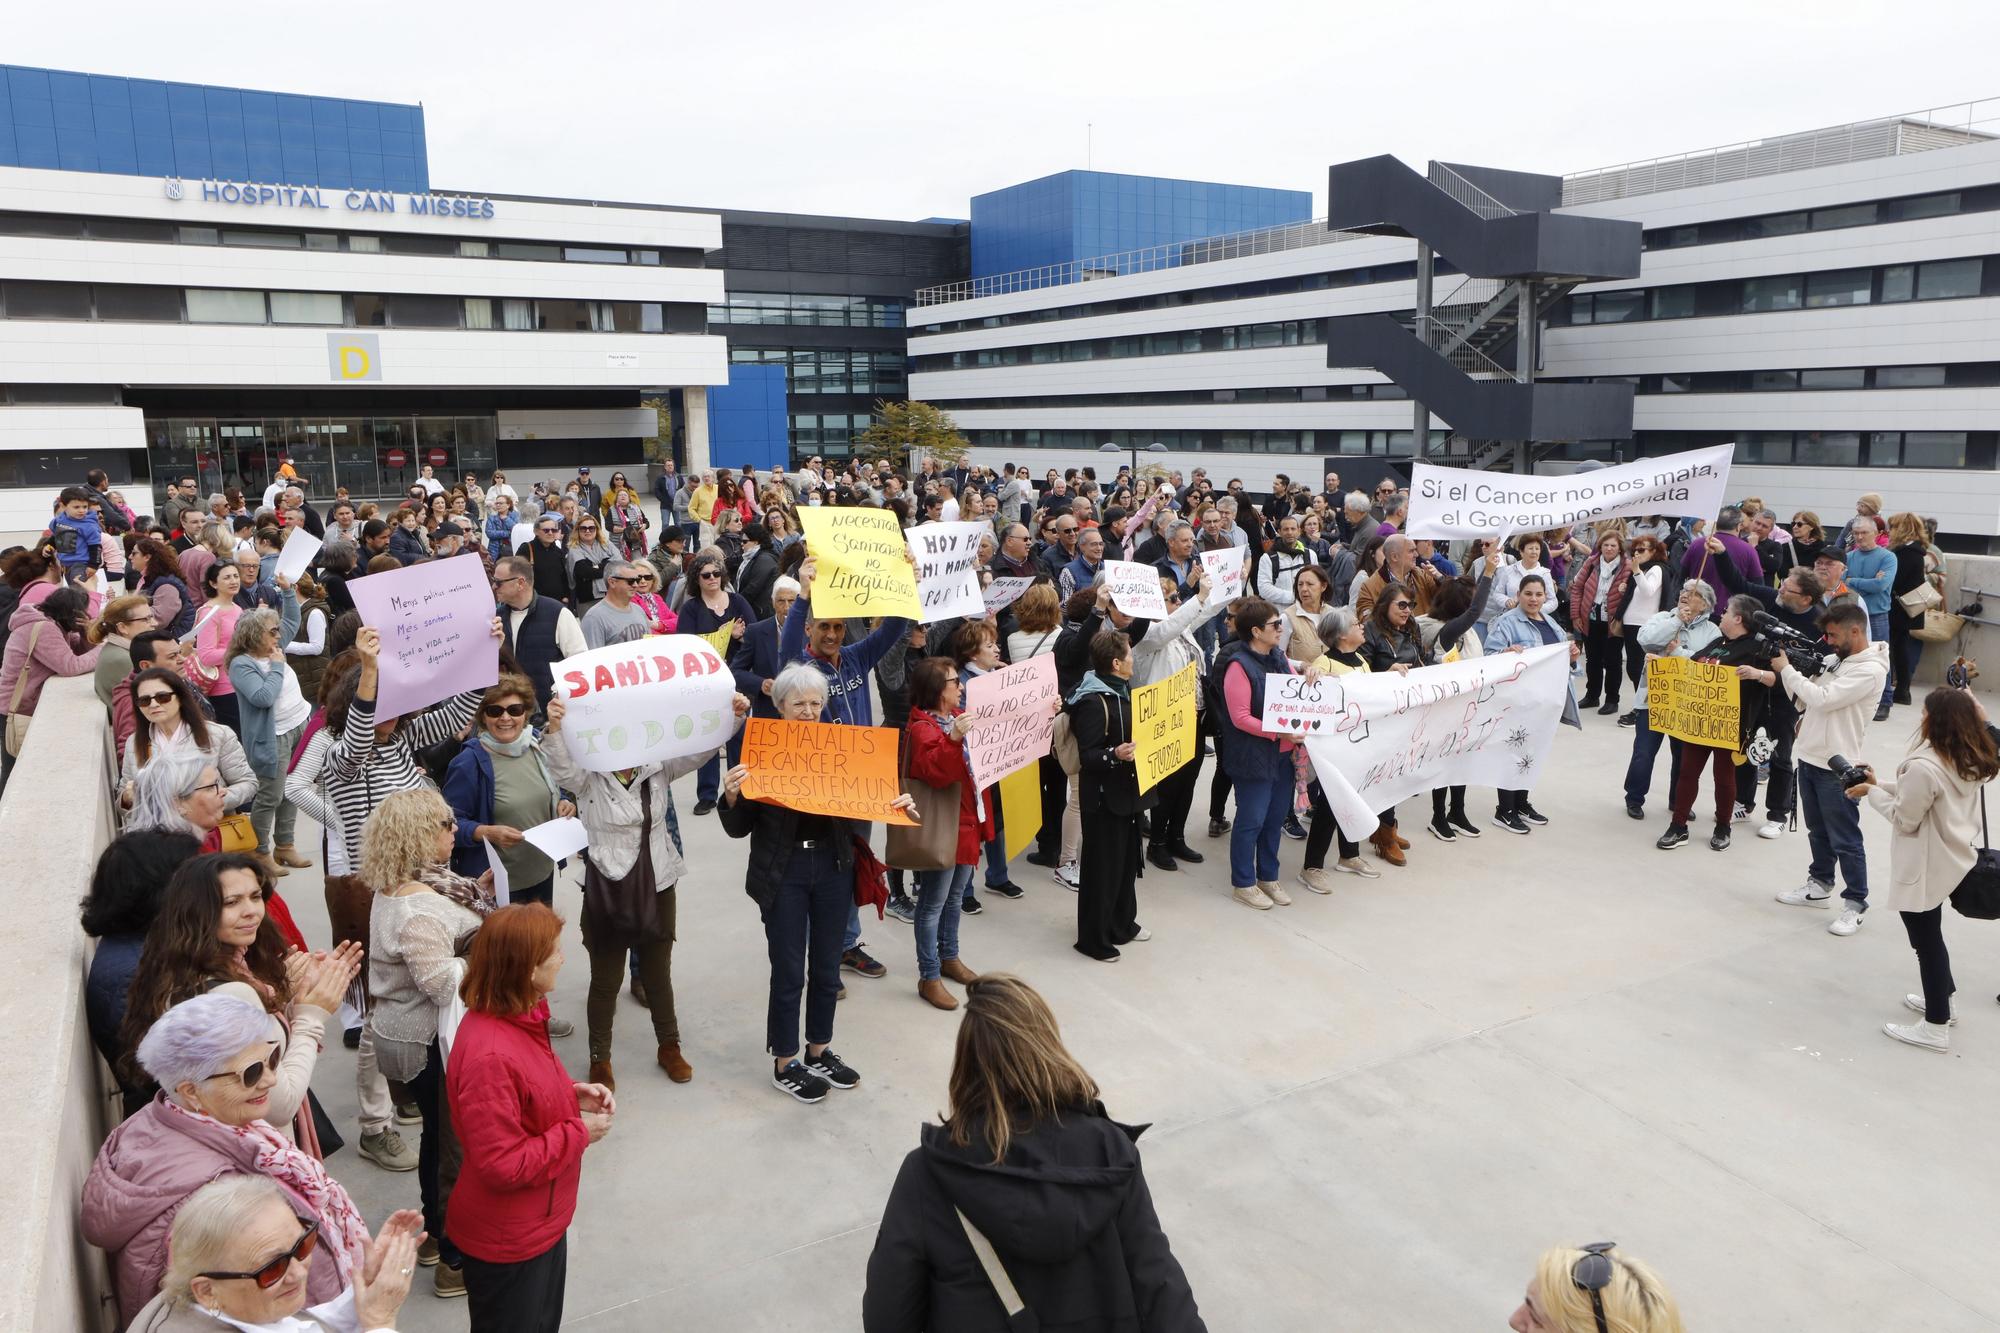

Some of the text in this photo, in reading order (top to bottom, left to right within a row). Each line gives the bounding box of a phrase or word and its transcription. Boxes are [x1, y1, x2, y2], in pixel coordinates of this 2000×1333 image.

[203, 183, 494, 219] HOSPITAL CAN MISSES
[341, 346, 369, 379] D
[1449, 483, 1467, 501] el
[1475, 484, 1558, 504] Cancer
[1566, 487, 1593, 502] no
[1602, 478, 1644, 496] nos
[1653, 462, 1718, 487] mata,
[1441, 510, 1459, 526] el
[1562, 506, 1603, 523] nos
[923, 535, 957, 554] HOY
[923, 563, 938, 578] MI
[1651, 658, 1679, 675] LA
[1649, 677, 1669, 690] NO
[999, 697, 1018, 715] no
[1139, 688, 1158, 723] MI
[1651, 693, 1669, 705] DE
[1171, 710, 1184, 731] LA
[576, 710, 721, 755] TODOS
[749, 722, 875, 755] ELS MALALTS
[748, 749, 767, 770] DE
[1148, 740, 1182, 779] TUYA
[750, 775, 897, 800] NECESSITEM UN
